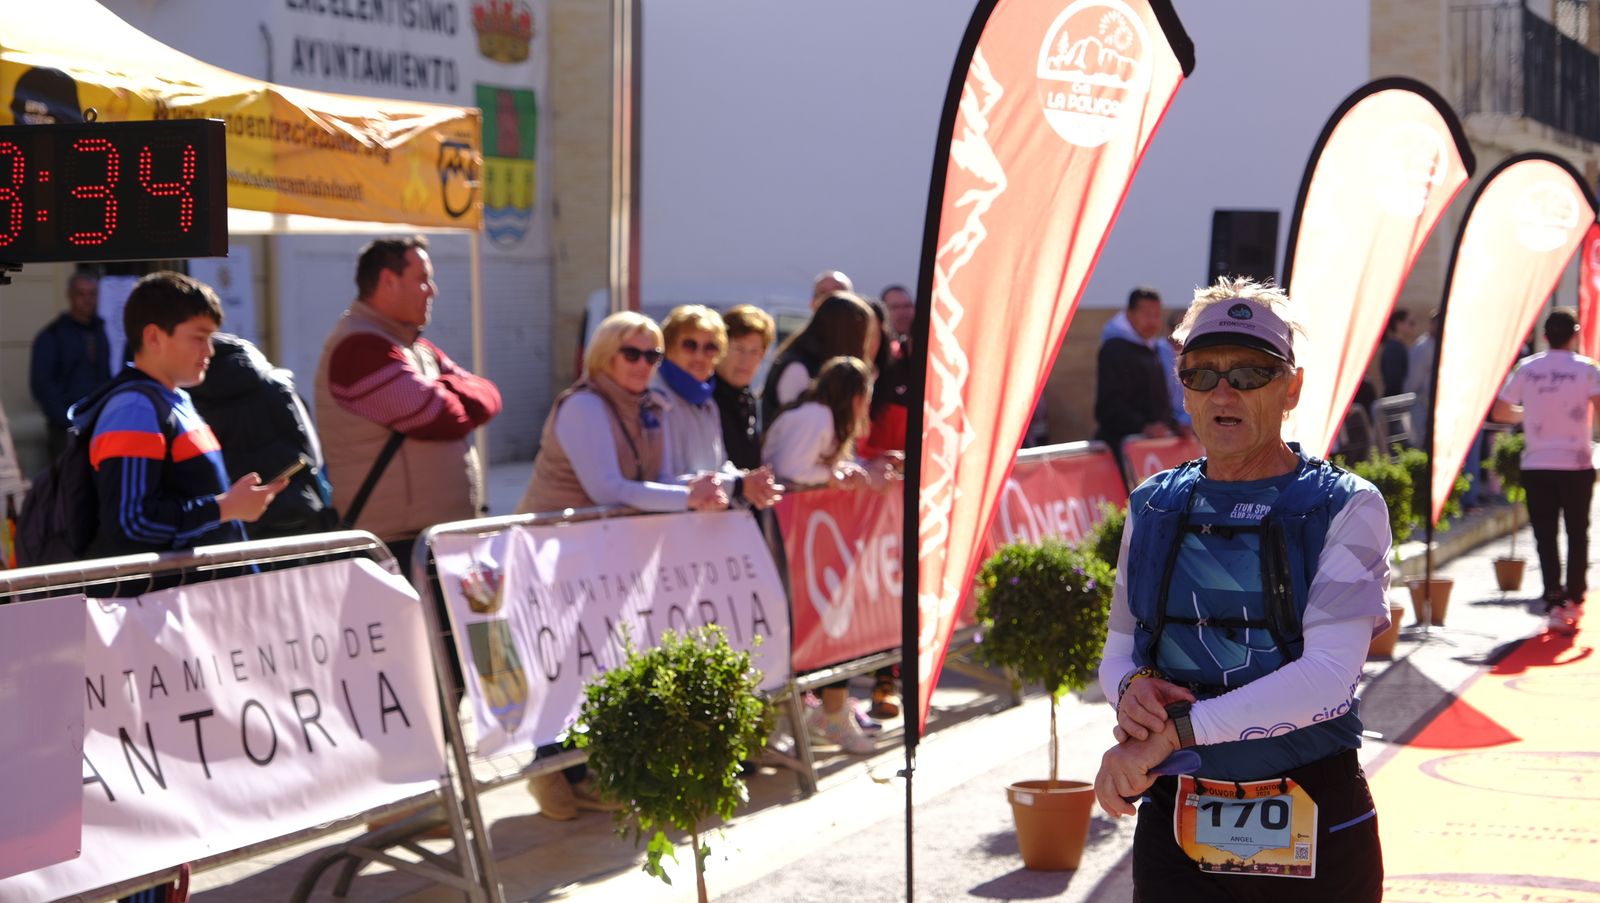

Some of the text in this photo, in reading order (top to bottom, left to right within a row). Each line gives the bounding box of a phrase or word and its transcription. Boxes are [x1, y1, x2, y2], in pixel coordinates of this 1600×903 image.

[291, 37, 458, 94] AYUNTAMIENTO
[726, 555, 758, 582] DE
[85, 622, 387, 711] NTAMIENTO DE
[82, 670, 411, 802] ANTORIA
[1201, 798, 1290, 830] 170
[1230, 835, 1254, 844] ANGEL
